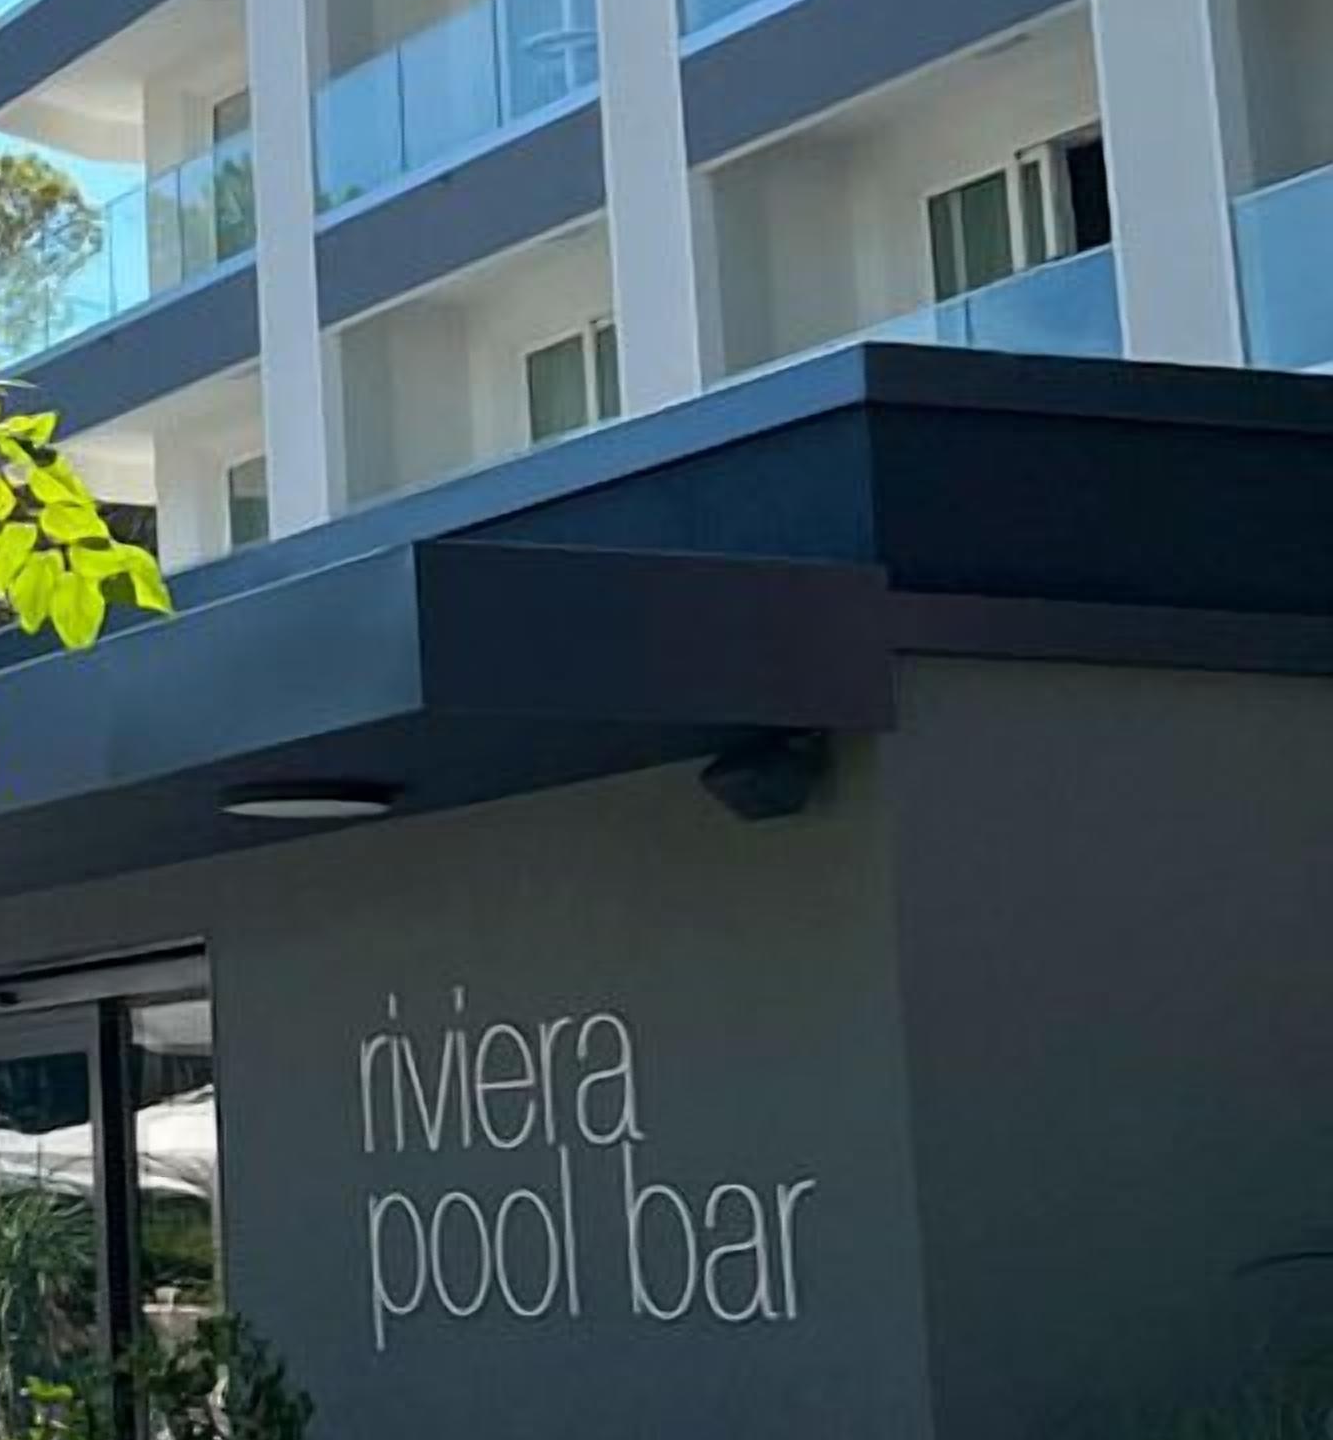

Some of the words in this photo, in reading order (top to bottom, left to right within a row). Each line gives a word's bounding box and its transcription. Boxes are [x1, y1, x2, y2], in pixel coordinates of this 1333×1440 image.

[359, 985, 645, 1152] riviera
[369, 1144, 581, 1351] pool
[622, 1140, 817, 1321] bar
